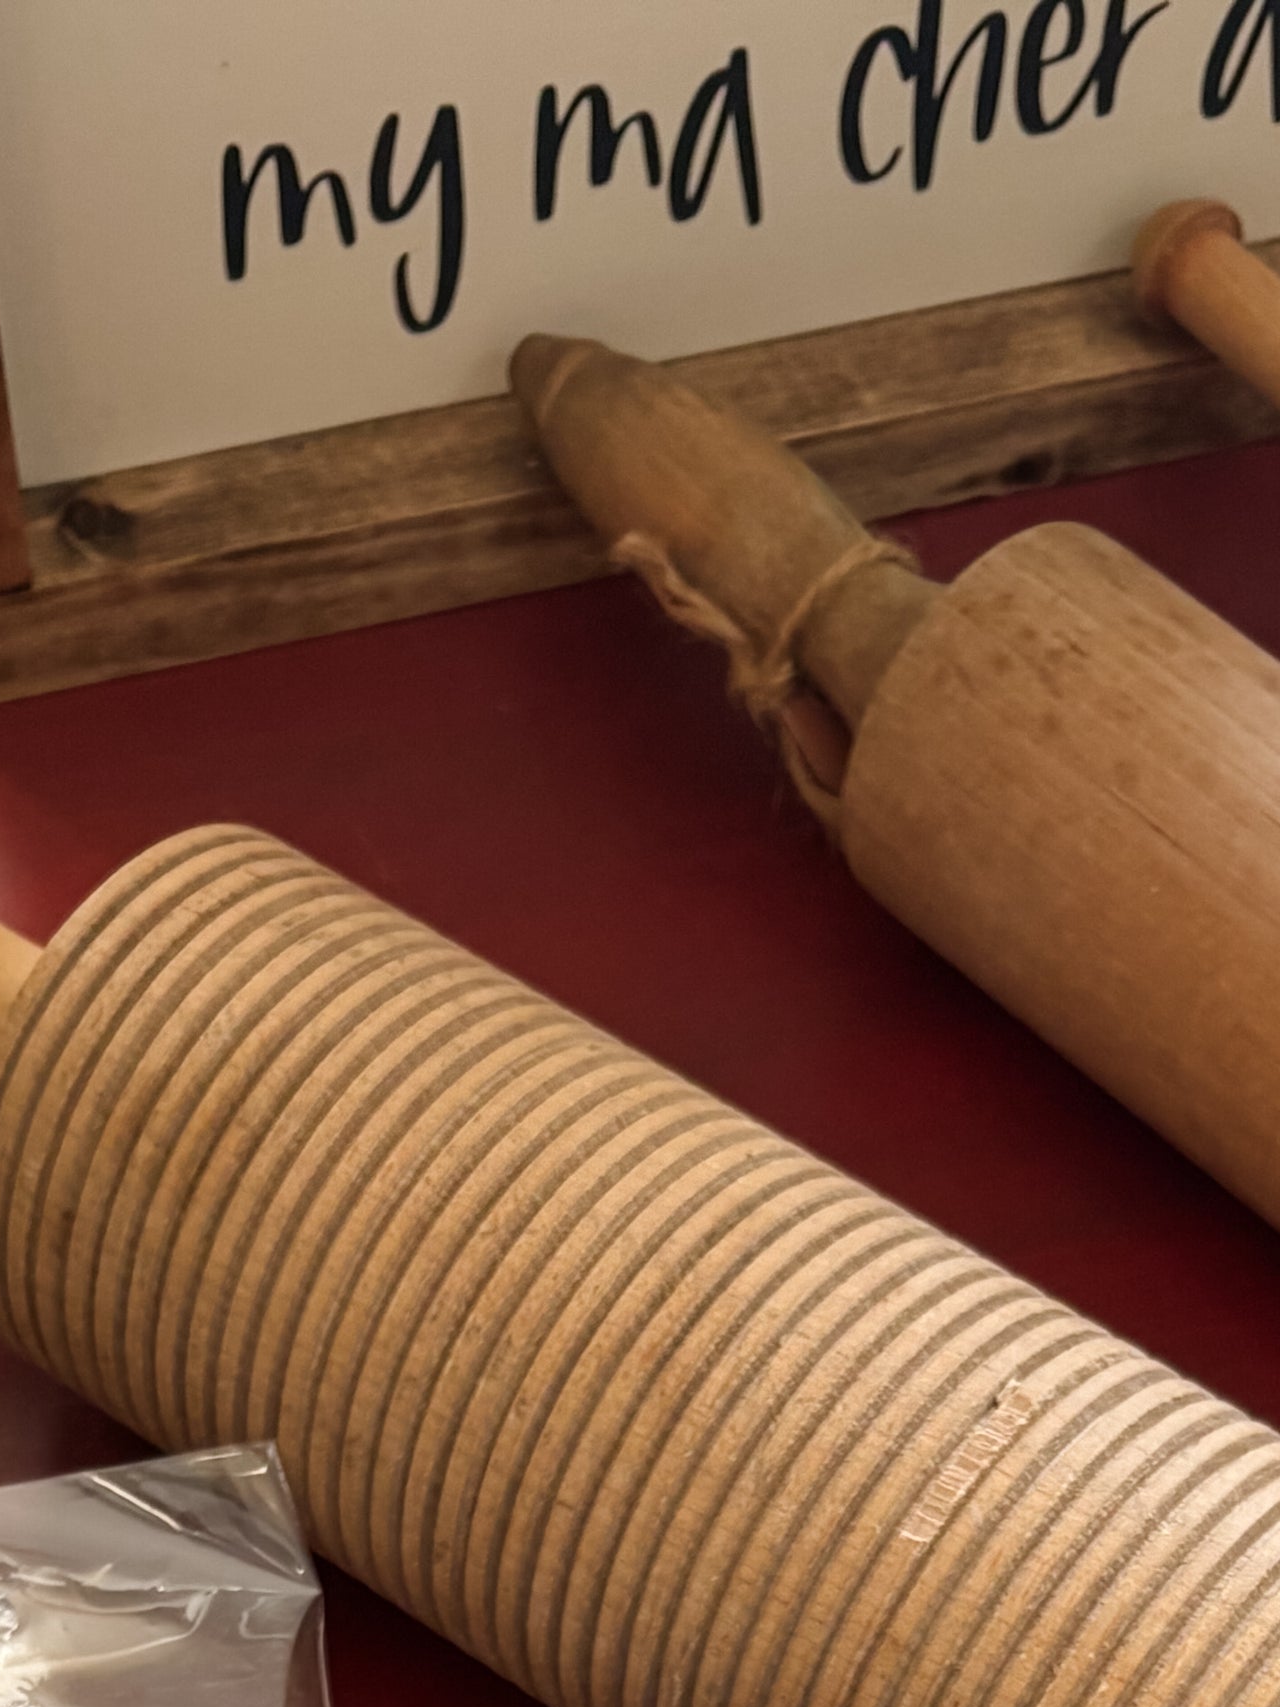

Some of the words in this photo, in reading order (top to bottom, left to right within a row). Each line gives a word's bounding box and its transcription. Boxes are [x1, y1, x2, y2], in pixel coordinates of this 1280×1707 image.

[221, 104, 465, 334] my
[534, 48, 762, 226] ma
[840, 0, 1169, 193] cher
